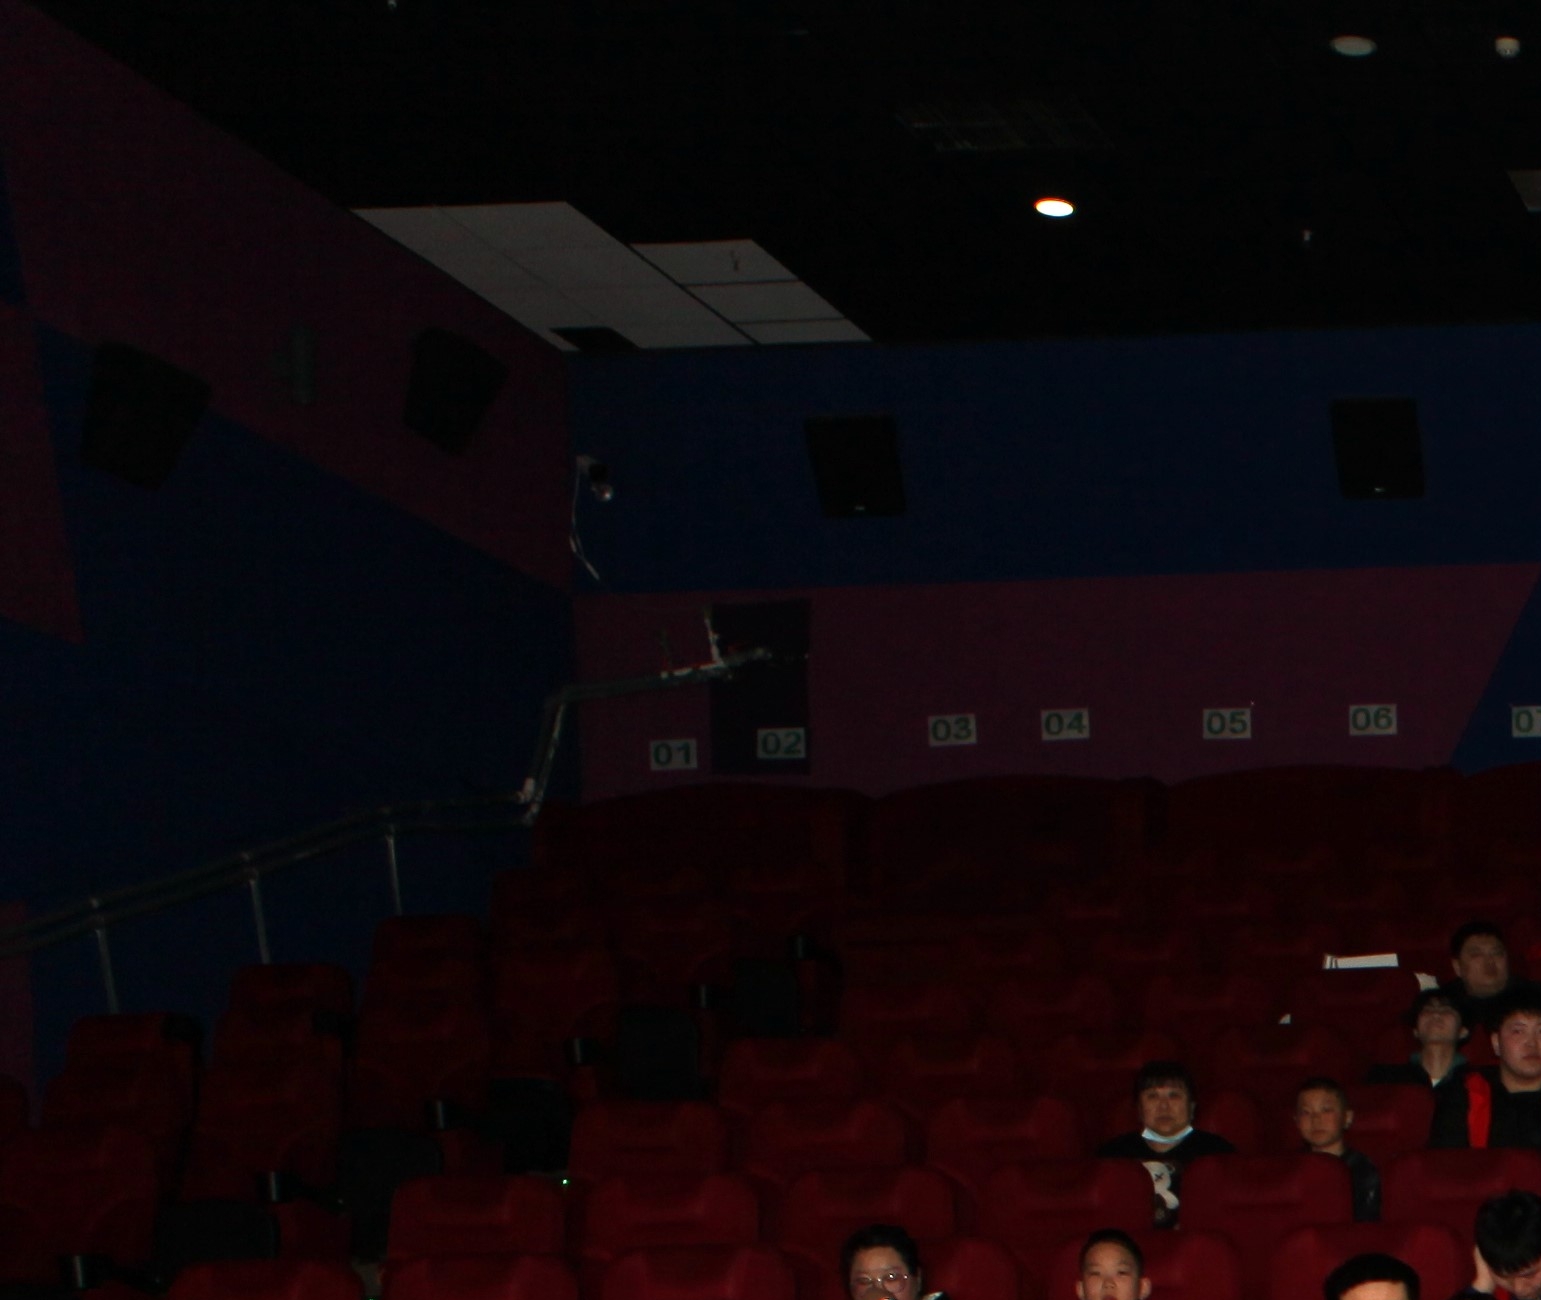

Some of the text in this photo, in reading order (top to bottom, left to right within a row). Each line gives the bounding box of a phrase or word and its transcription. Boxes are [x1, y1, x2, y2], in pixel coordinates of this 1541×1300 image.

[931, 717, 971, 742] 03
[1044, 712, 1086, 736] 04
[1206, 711, 1247, 735] 05
[1351, 707, 1393, 731] 06
[652, 742, 691, 765] 01
[761, 732, 801, 755] 02
